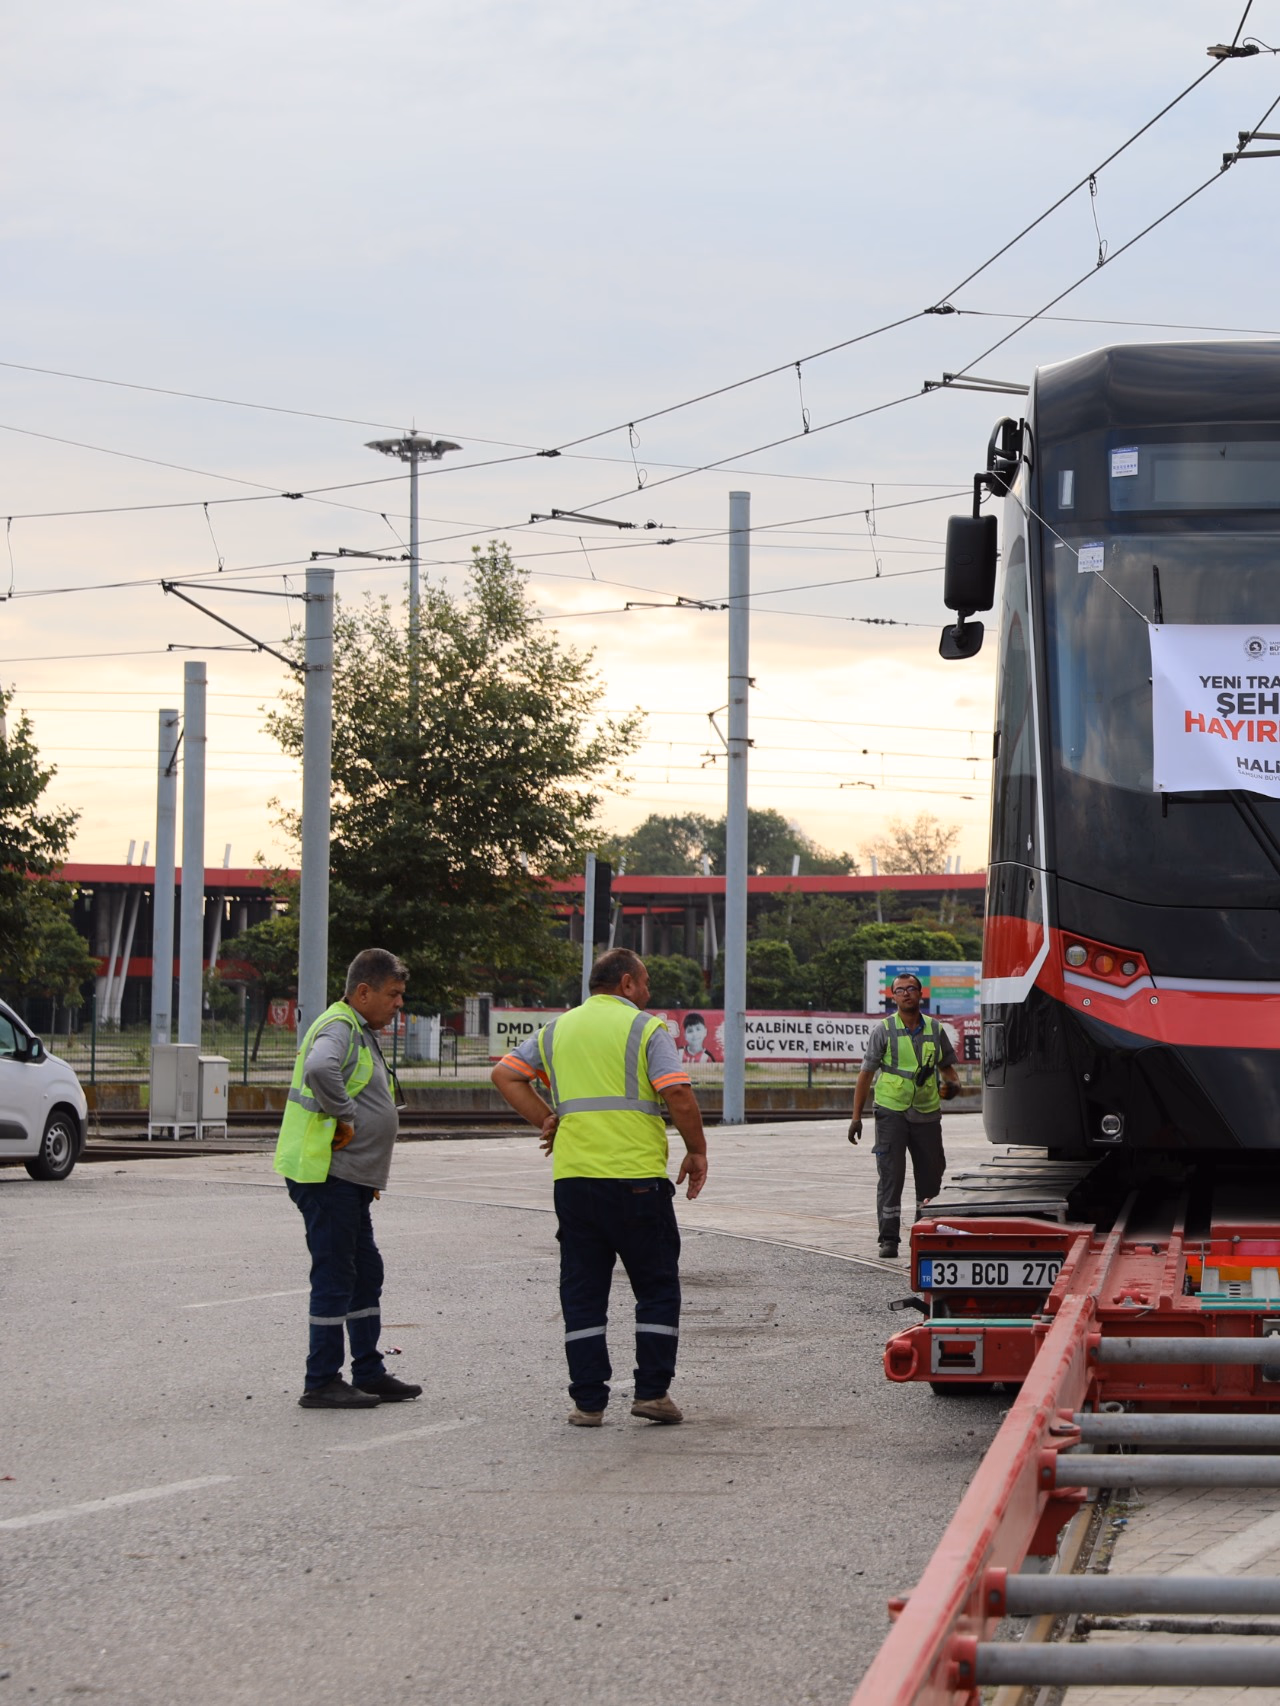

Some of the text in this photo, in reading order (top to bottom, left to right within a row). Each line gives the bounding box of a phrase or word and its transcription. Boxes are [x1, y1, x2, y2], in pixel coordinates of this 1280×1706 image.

[497, 1022, 533, 1034] DMD
[745, 1020, 869, 1036] KALBİNLE GÖNDER
[746, 1037, 774, 1053] GÜÇ
[778, 1040, 809, 1053] VER,
[813, 1038, 854, 1052] EMİR'e
[933, 1262, 959, 1286] 33
[971, 1262, 1009, 1286] BCD
[1022, 1262, 1060, 1286] 270
